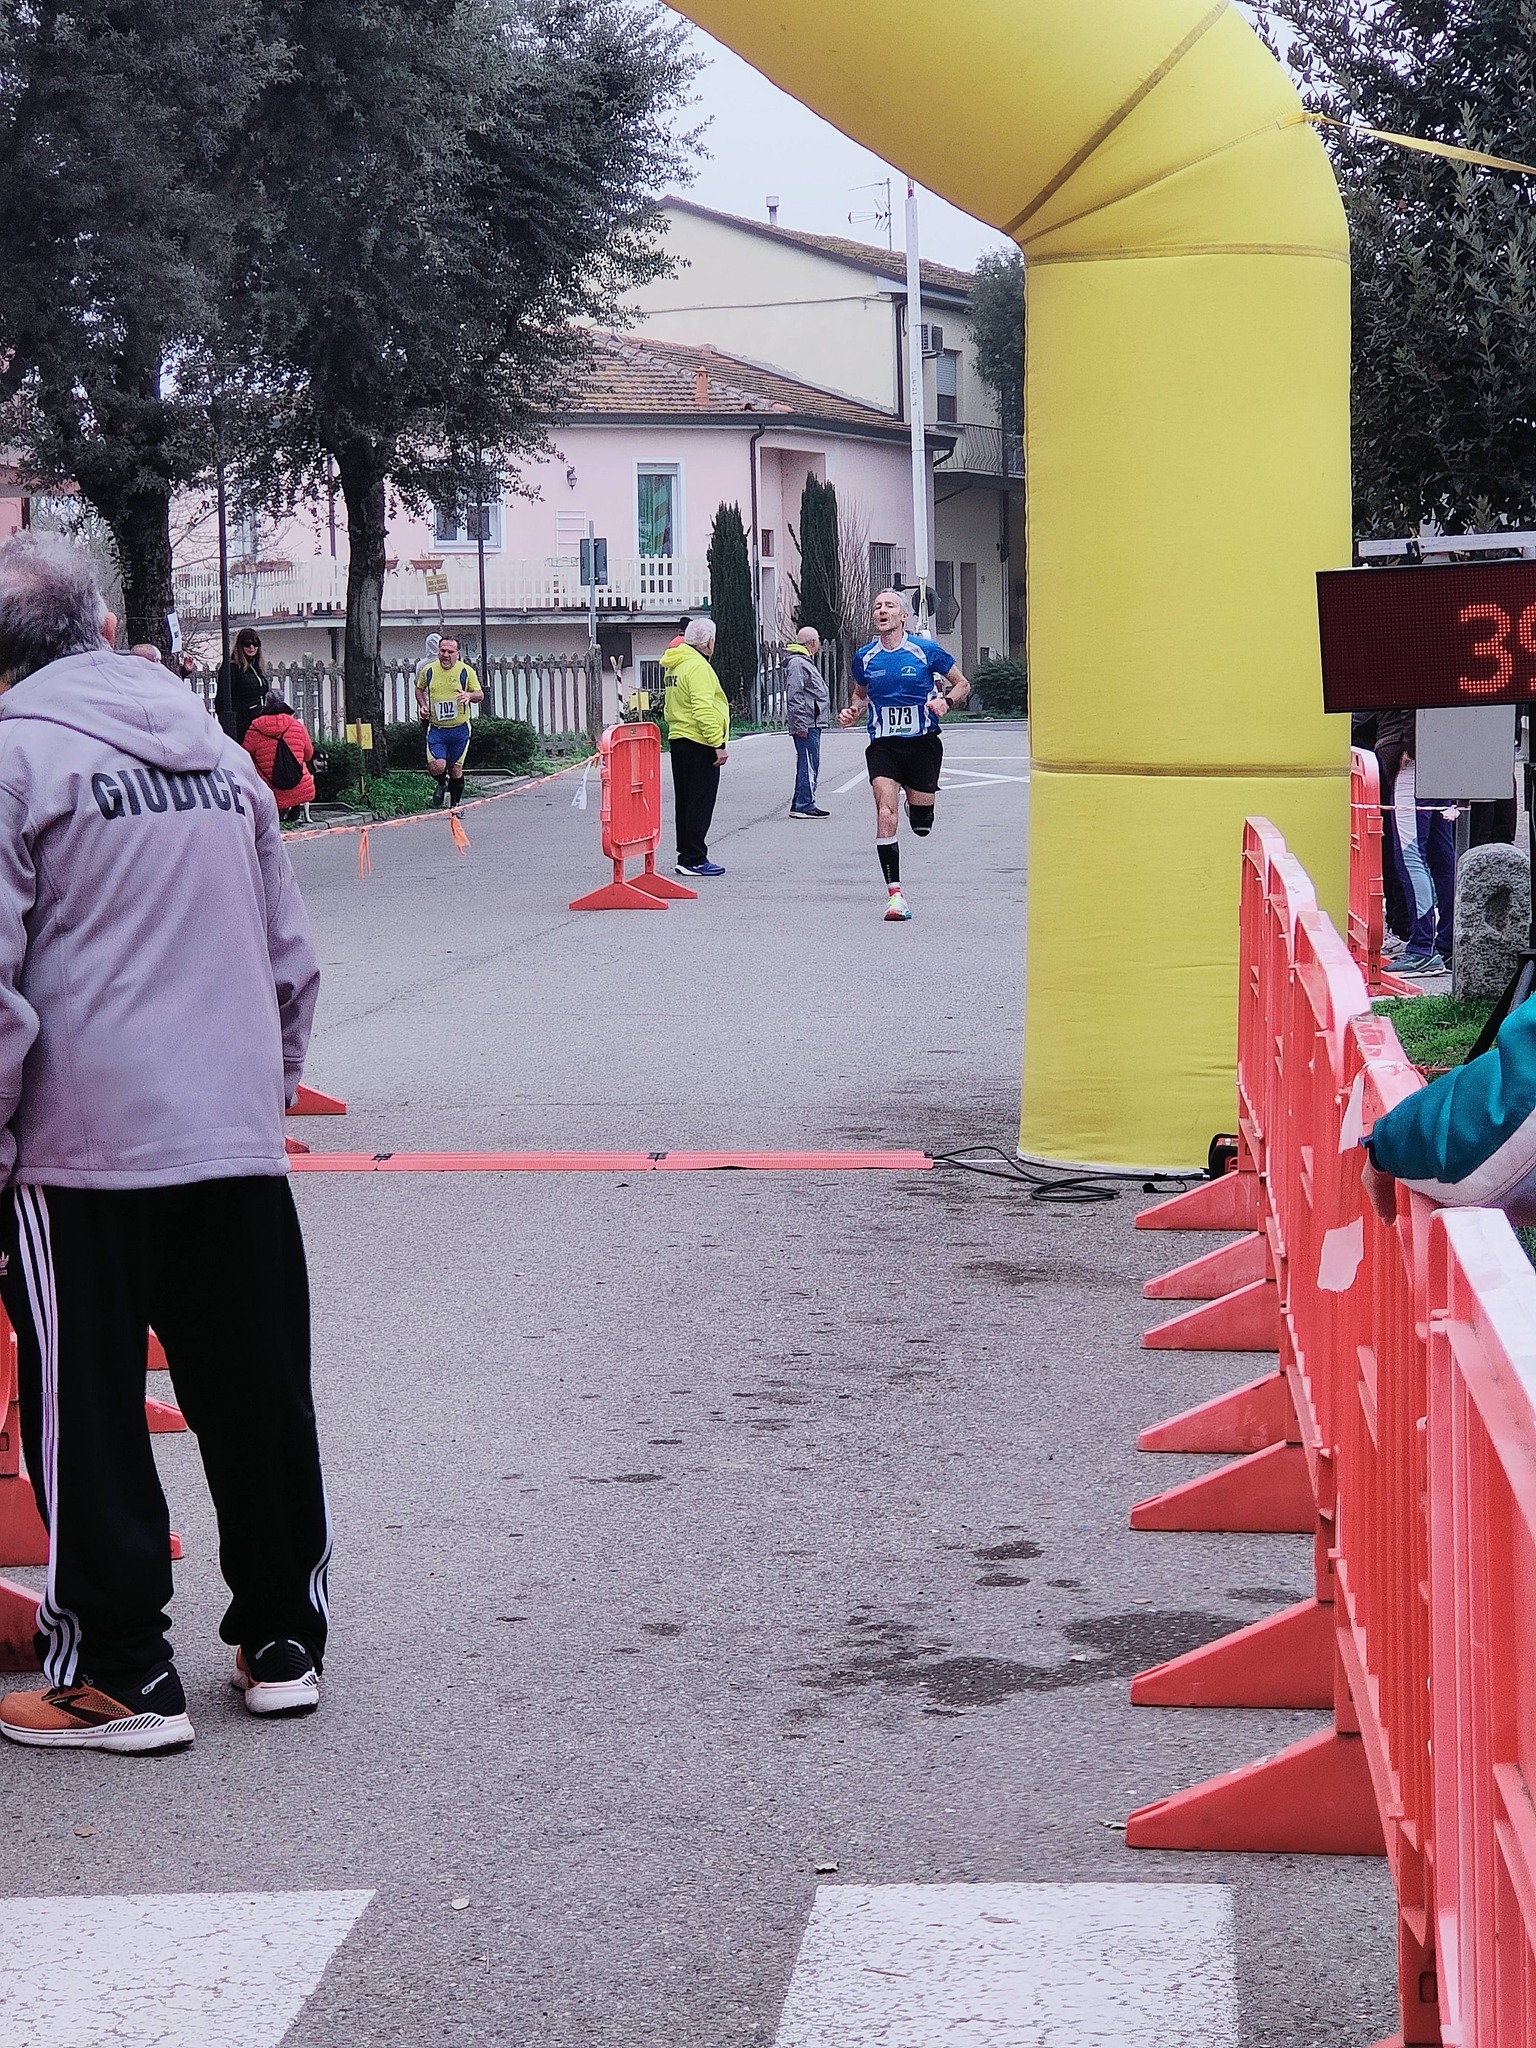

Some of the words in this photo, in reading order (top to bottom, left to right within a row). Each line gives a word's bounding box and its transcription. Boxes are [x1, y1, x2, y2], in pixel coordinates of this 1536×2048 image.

[439, 702, 455, 714] 702
[888, 707, 912, 726] 673
[91, 767, 246, 820] GIUDICE
